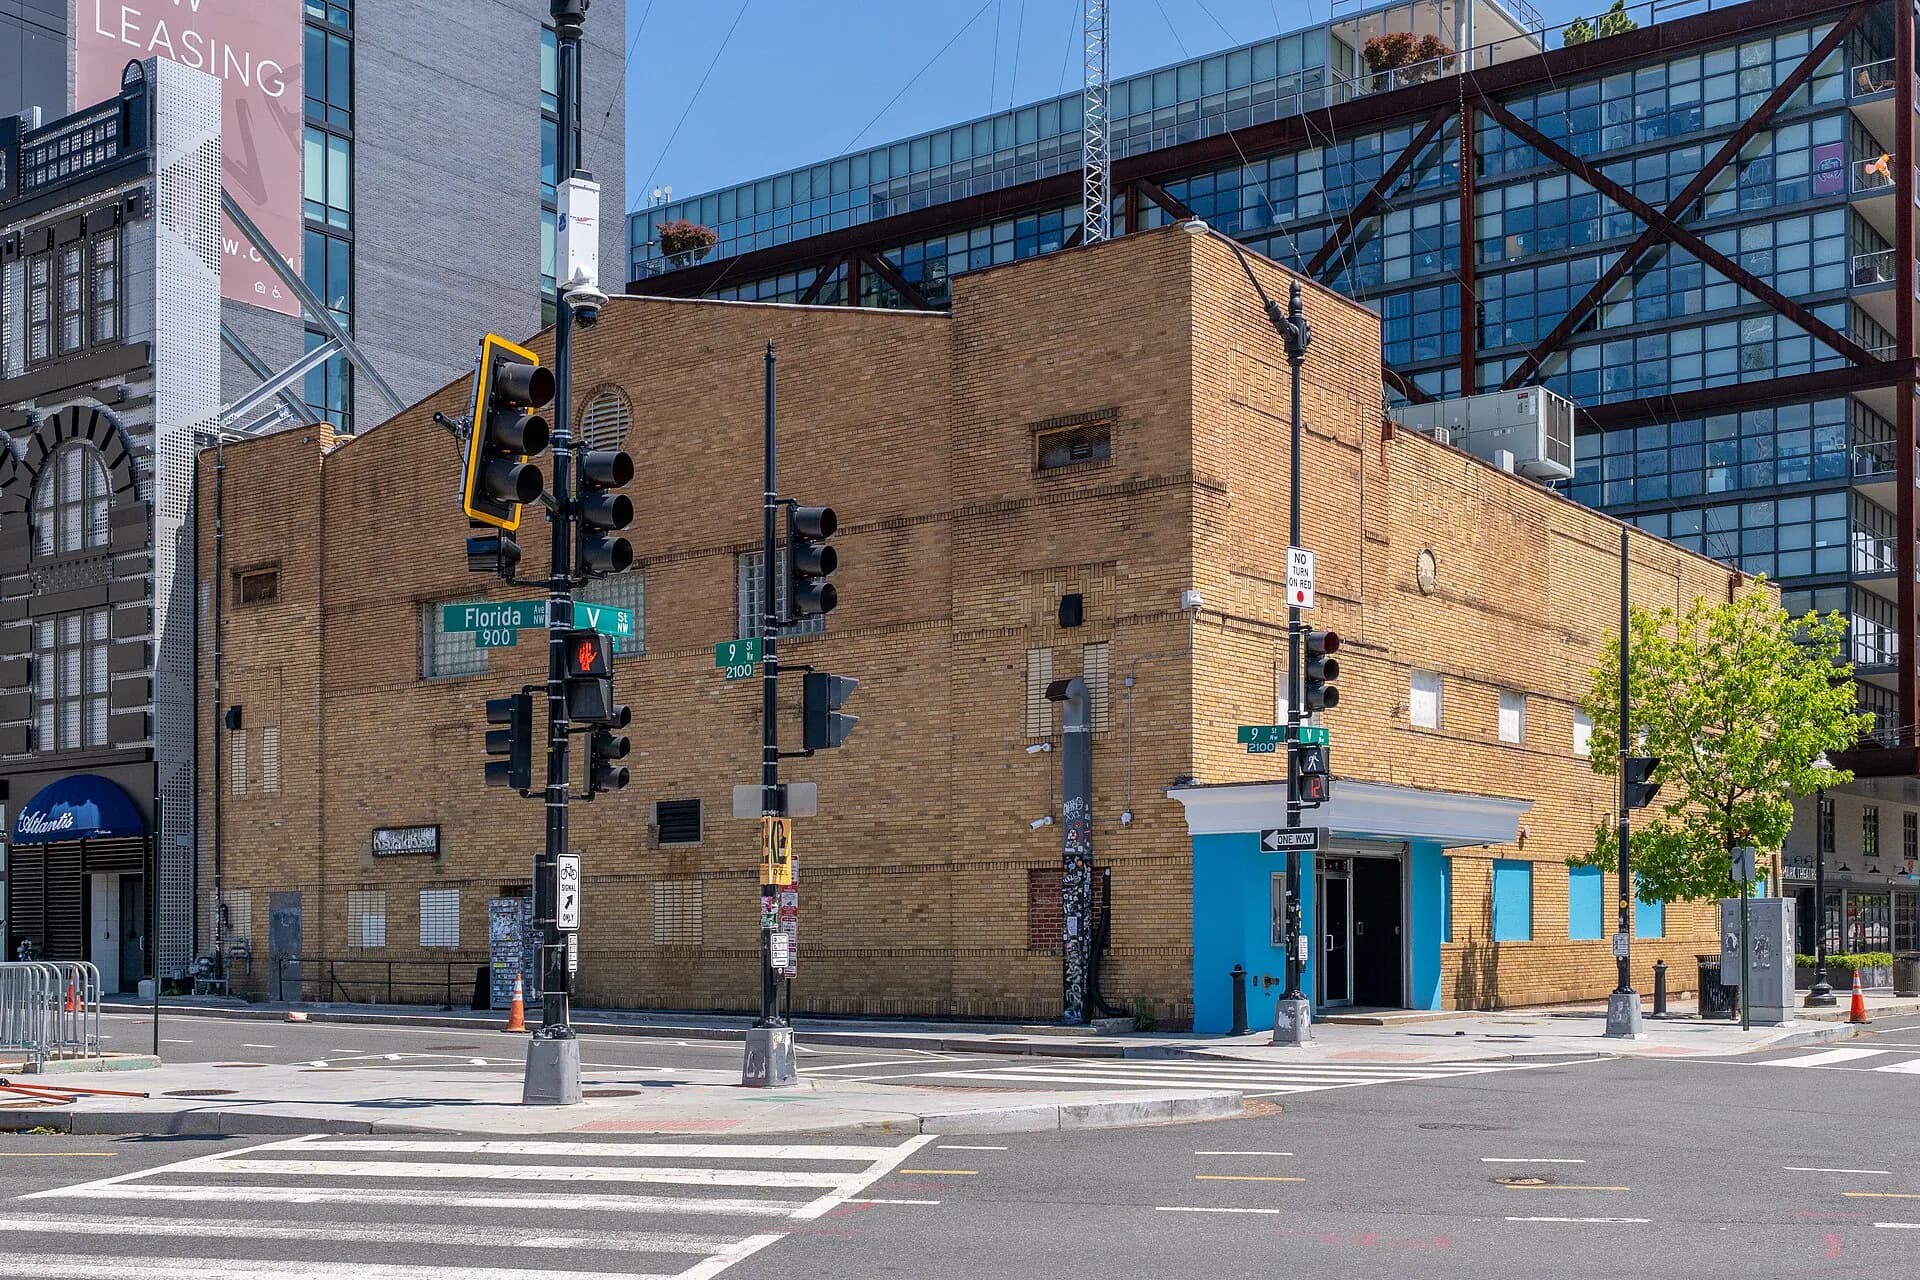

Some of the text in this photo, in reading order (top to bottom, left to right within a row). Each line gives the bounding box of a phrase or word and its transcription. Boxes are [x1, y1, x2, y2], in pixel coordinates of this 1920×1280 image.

[96, 0, 285, 97] LEASING
[1294, 552, 1306, 565] NO
[1292, 566, 1309, 577] TURN
[1289, 577, 1312, 590] ON RED
[533, 604, 545, 615] Ave
[465, 606, 521, 628] Florida
[533, 614, 545, 626] NW
[586, 607, 600, 628] V
[617, 611, 628, 623] St
[617, 622, 629, 634] NW
[483, 628, 510, 647] 900
[729, 643, 736, 662] 9
[726, 663, 752, 679] 2100
[1251, 727, 1259, 741] 9
[1306, 728, 1313, 743] V
[1248, 742, 1275, 752] 2100
[1311, 779, 1320, 798] 12
[18, 810, 74, 834] Atlantis
[1277, 833, 1313, 845] ONE WAY
[561, 884, 576, 892] SIGNAL
[563, 913, 574, 923] ONLY
